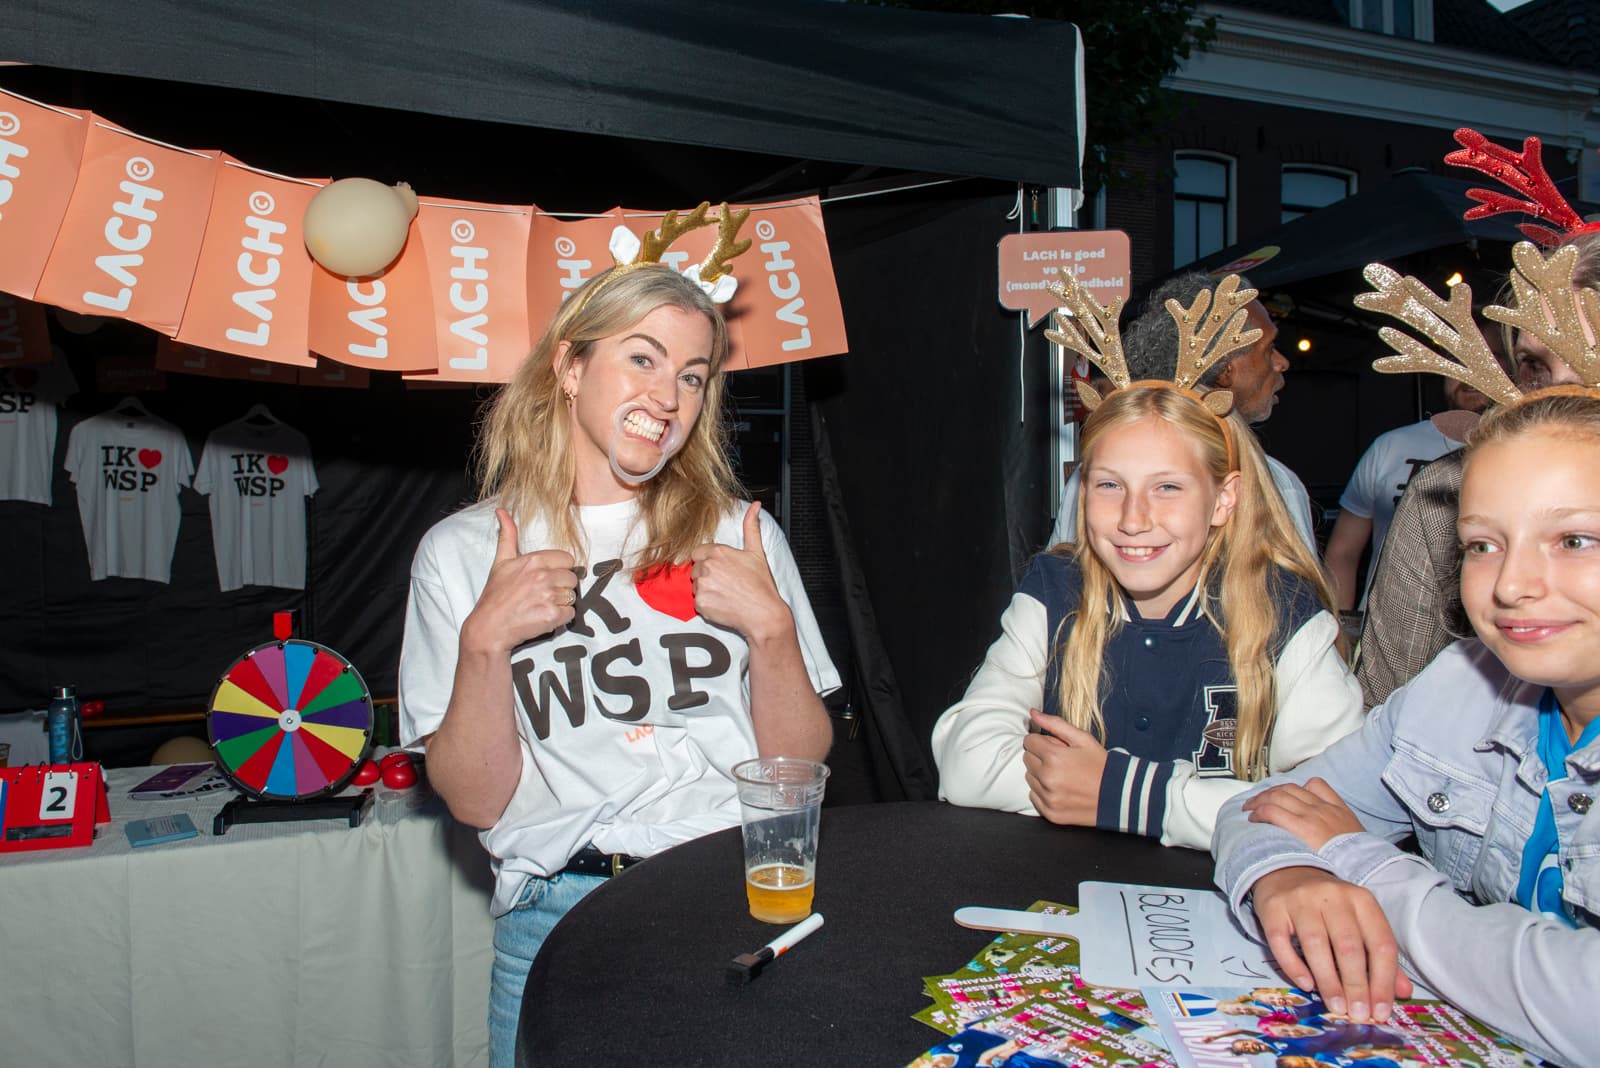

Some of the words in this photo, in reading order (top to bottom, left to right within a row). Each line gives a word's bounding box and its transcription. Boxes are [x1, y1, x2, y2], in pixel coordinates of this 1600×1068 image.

[1023, 250, 1057, 261] LACH
[1074, 248, 1105, 261] good
[346, 277, 388, 359] LAC
[0, 391, 35, 413] SP
[101, 446, 137, 468] IK
[231, 453, 265, 475] IK
[103, 470, 158, 493] WSP
[234, 476, 285, 498] WSP
[566, 558, 632, 638] K
[511, 632, 732, 741] WSP
[624, 722, 654, 744] LAC
[46, 786, 67, 812] 2
